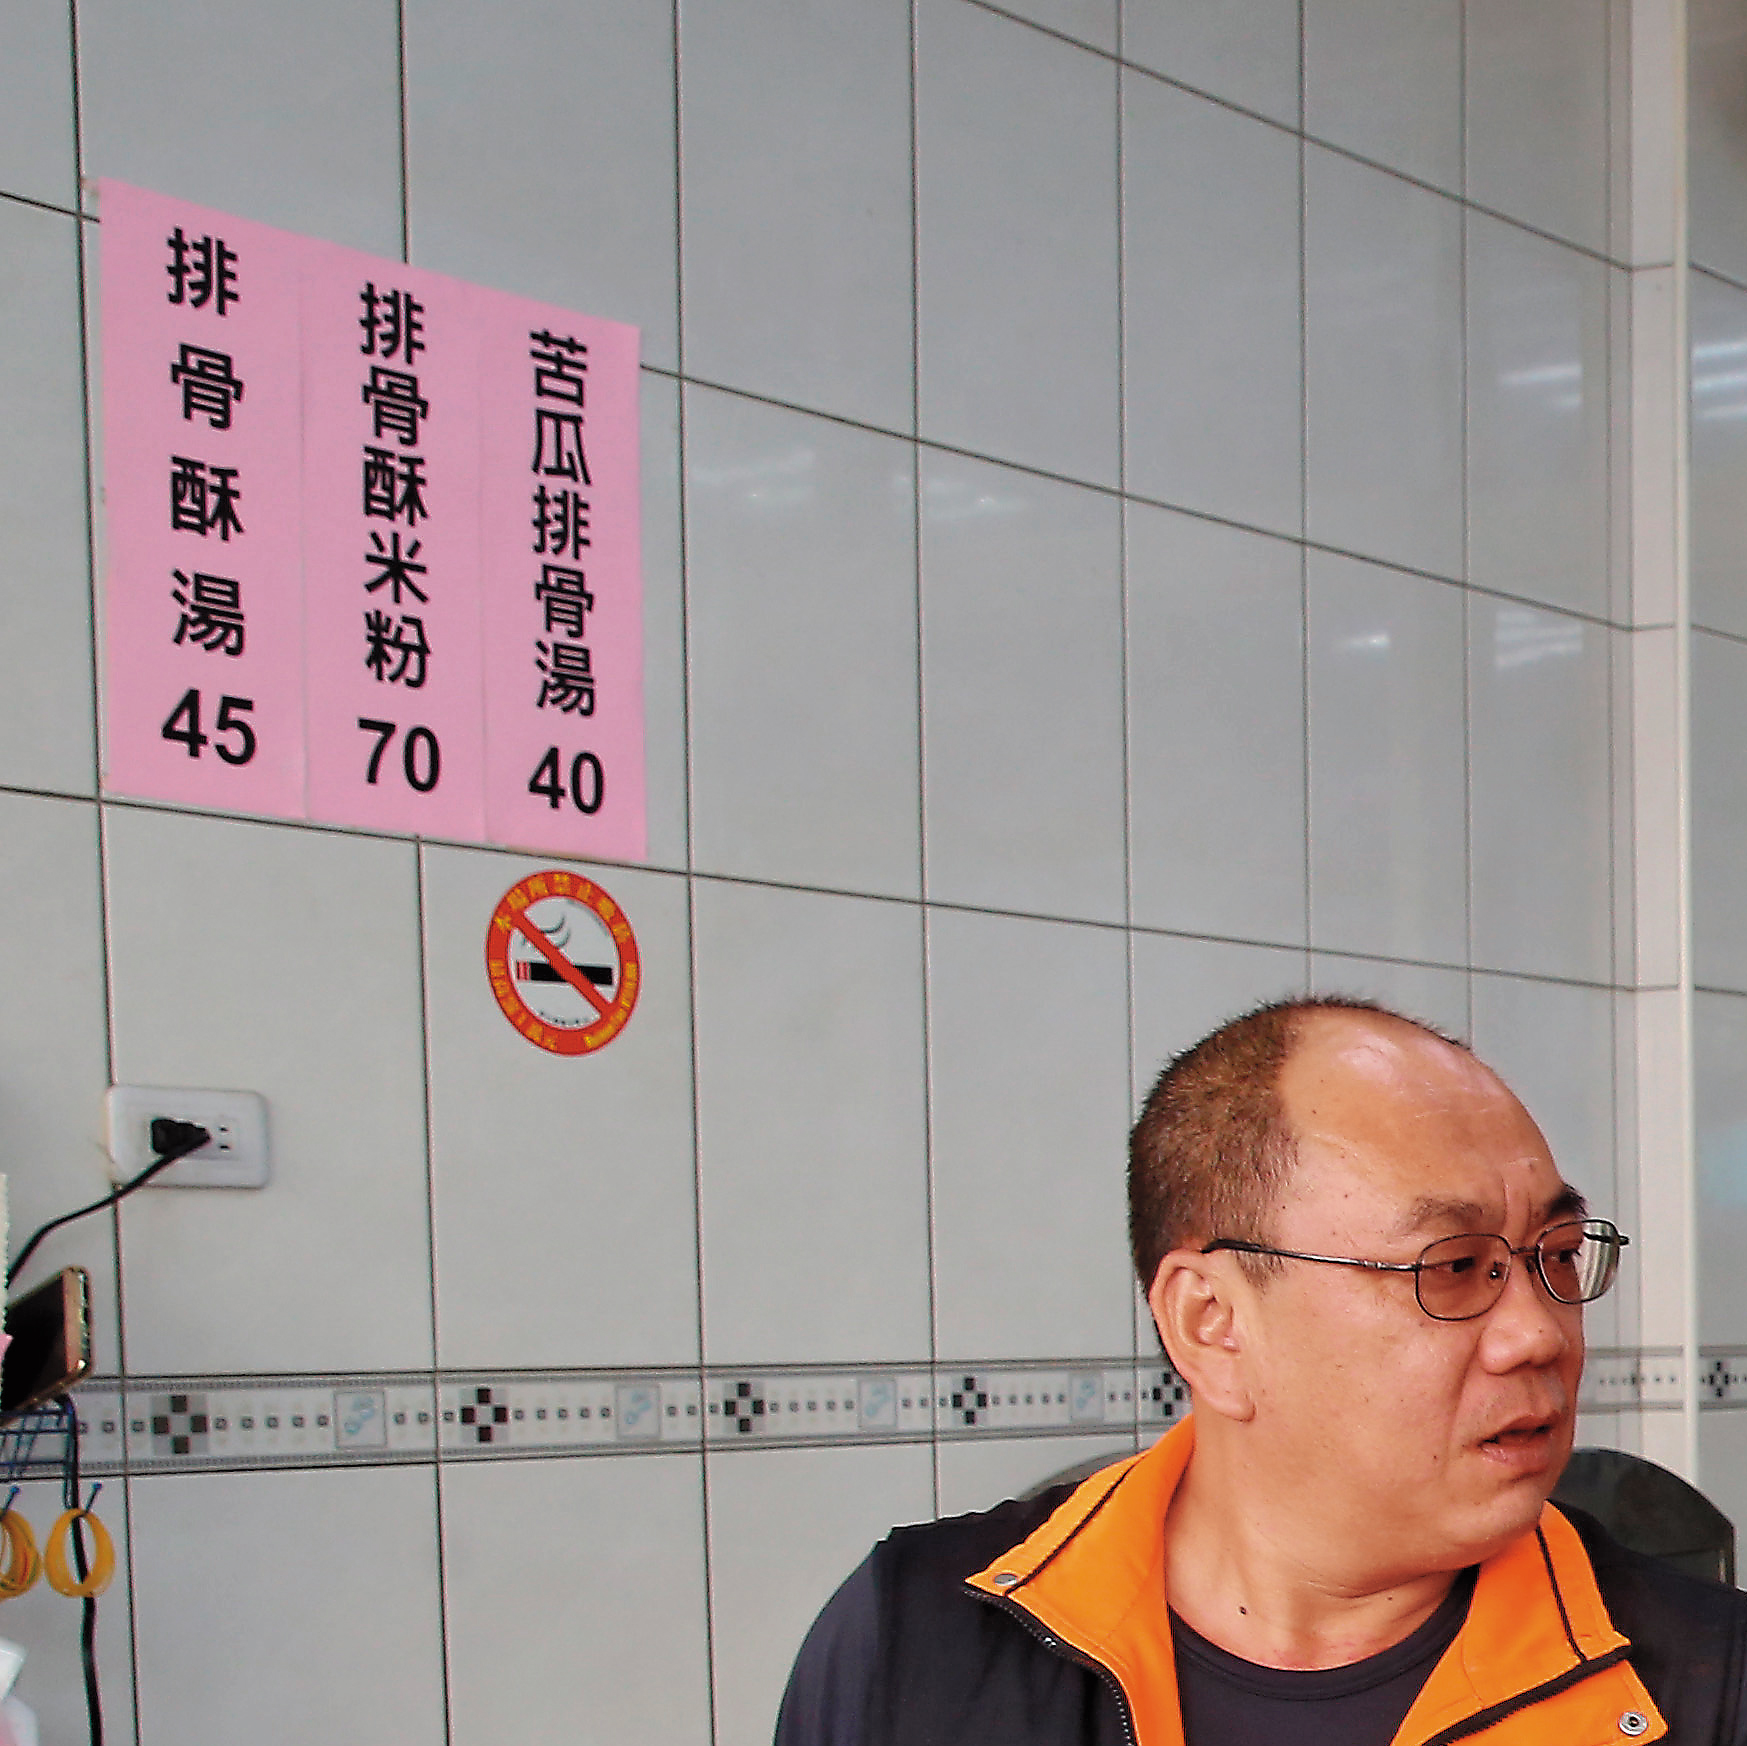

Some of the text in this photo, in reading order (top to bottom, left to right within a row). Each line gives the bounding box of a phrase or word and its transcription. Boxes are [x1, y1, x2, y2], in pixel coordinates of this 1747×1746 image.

[160, 226, 257, 767] 排骨酥湯 45
[357, 281, 442, 794] 排骨酥米粉 70
[529, 329, 597, 718] 苦瓜排骨湯
[527, 745, 606, 816] 40
